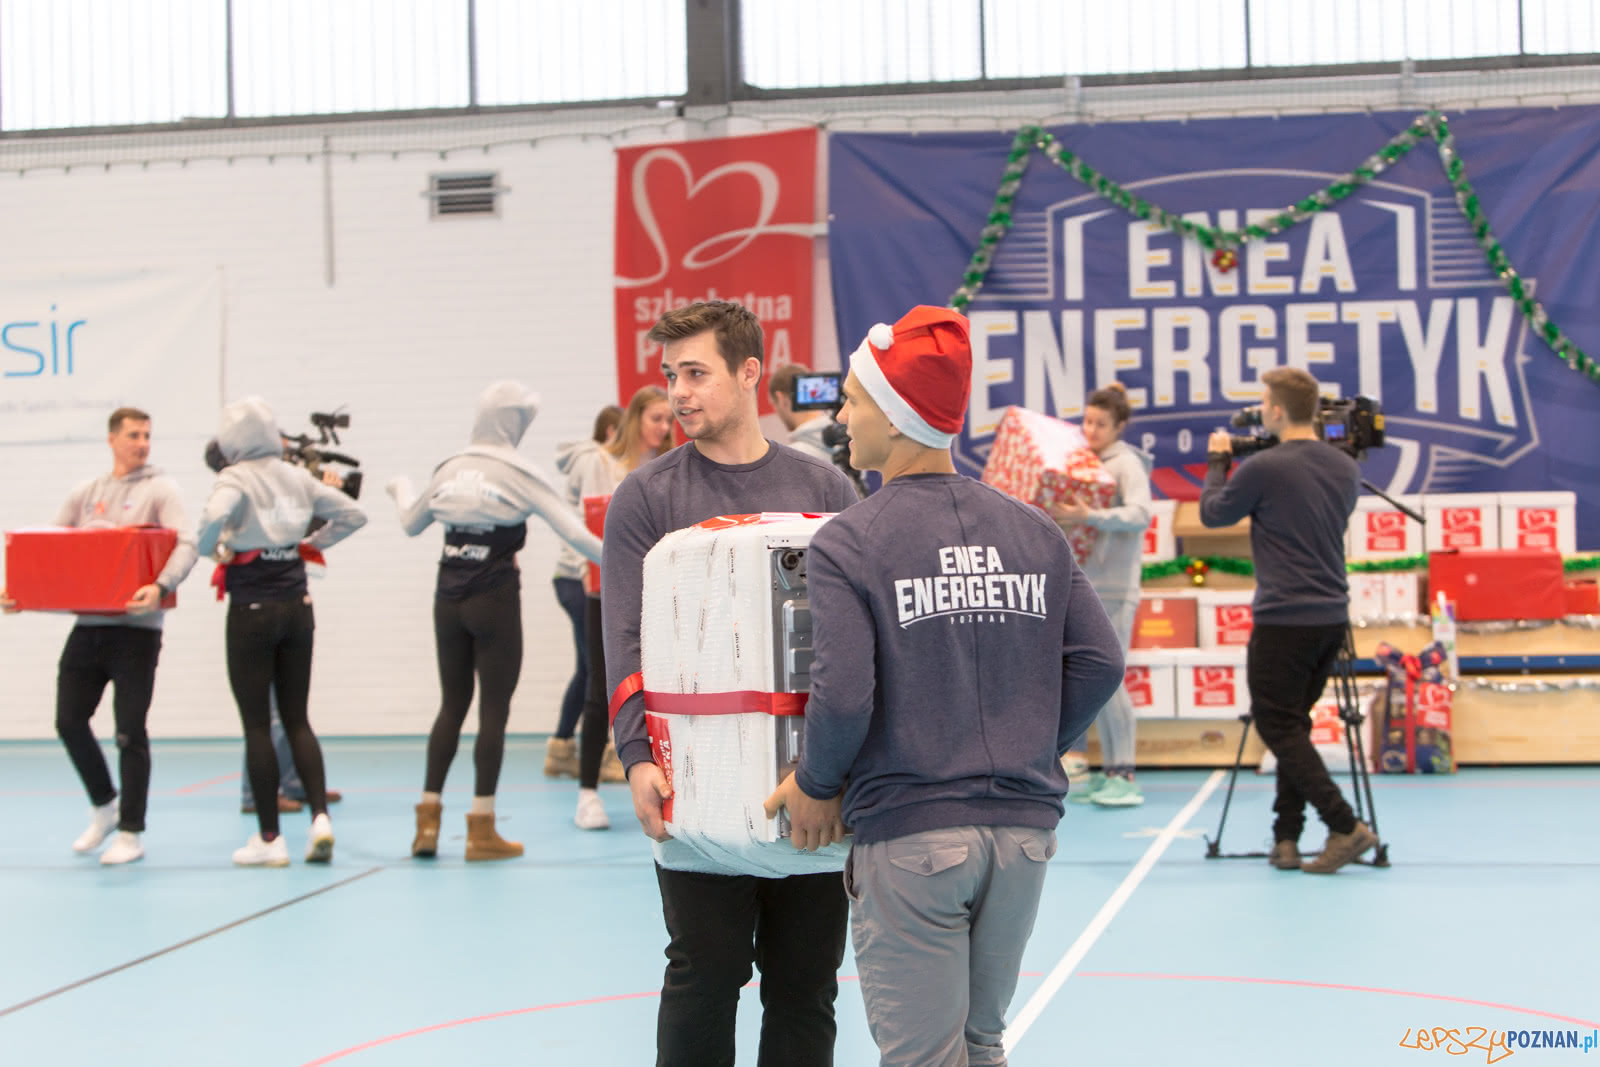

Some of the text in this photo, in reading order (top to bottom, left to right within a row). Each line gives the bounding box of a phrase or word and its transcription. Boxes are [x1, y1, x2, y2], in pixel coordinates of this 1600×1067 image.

[1128, 209, 1356, 298] ENEA
[967, 297, 1517, 438] ENERGETYK
[939, 546, 1004, 574] ENEA
[894, 573, 1047, 623] ENERGETYK
